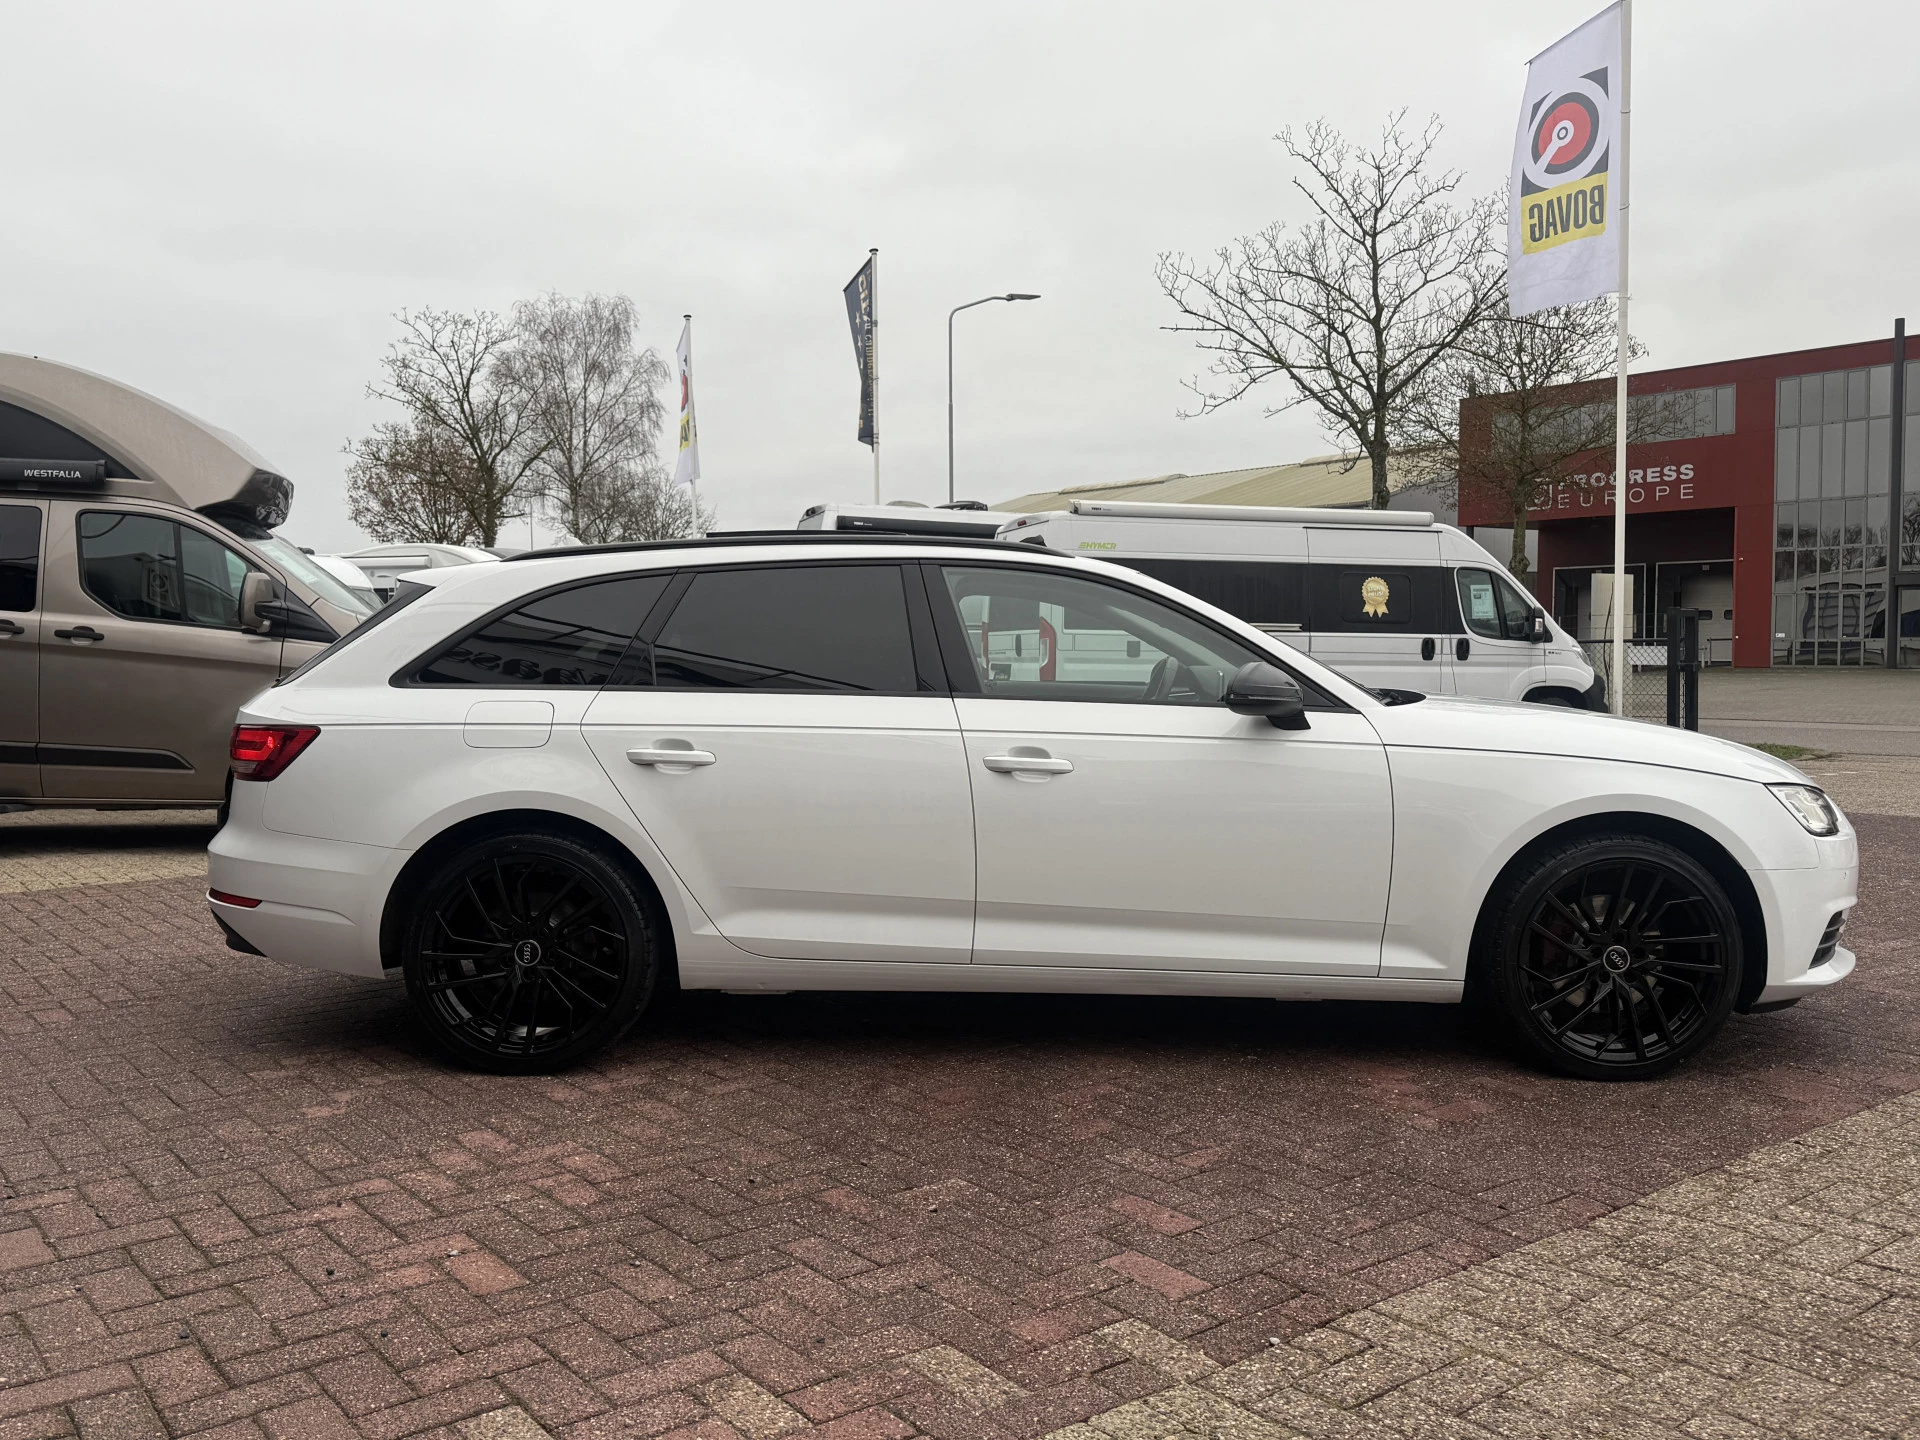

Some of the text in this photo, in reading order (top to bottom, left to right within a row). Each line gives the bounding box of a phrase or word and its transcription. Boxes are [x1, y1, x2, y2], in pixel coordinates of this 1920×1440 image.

[24, 469, 81, 479] WESTFALIA
[1558, 464, 1694, 490] RORESS
[1558, 484, 1694, 508] EUROPE
